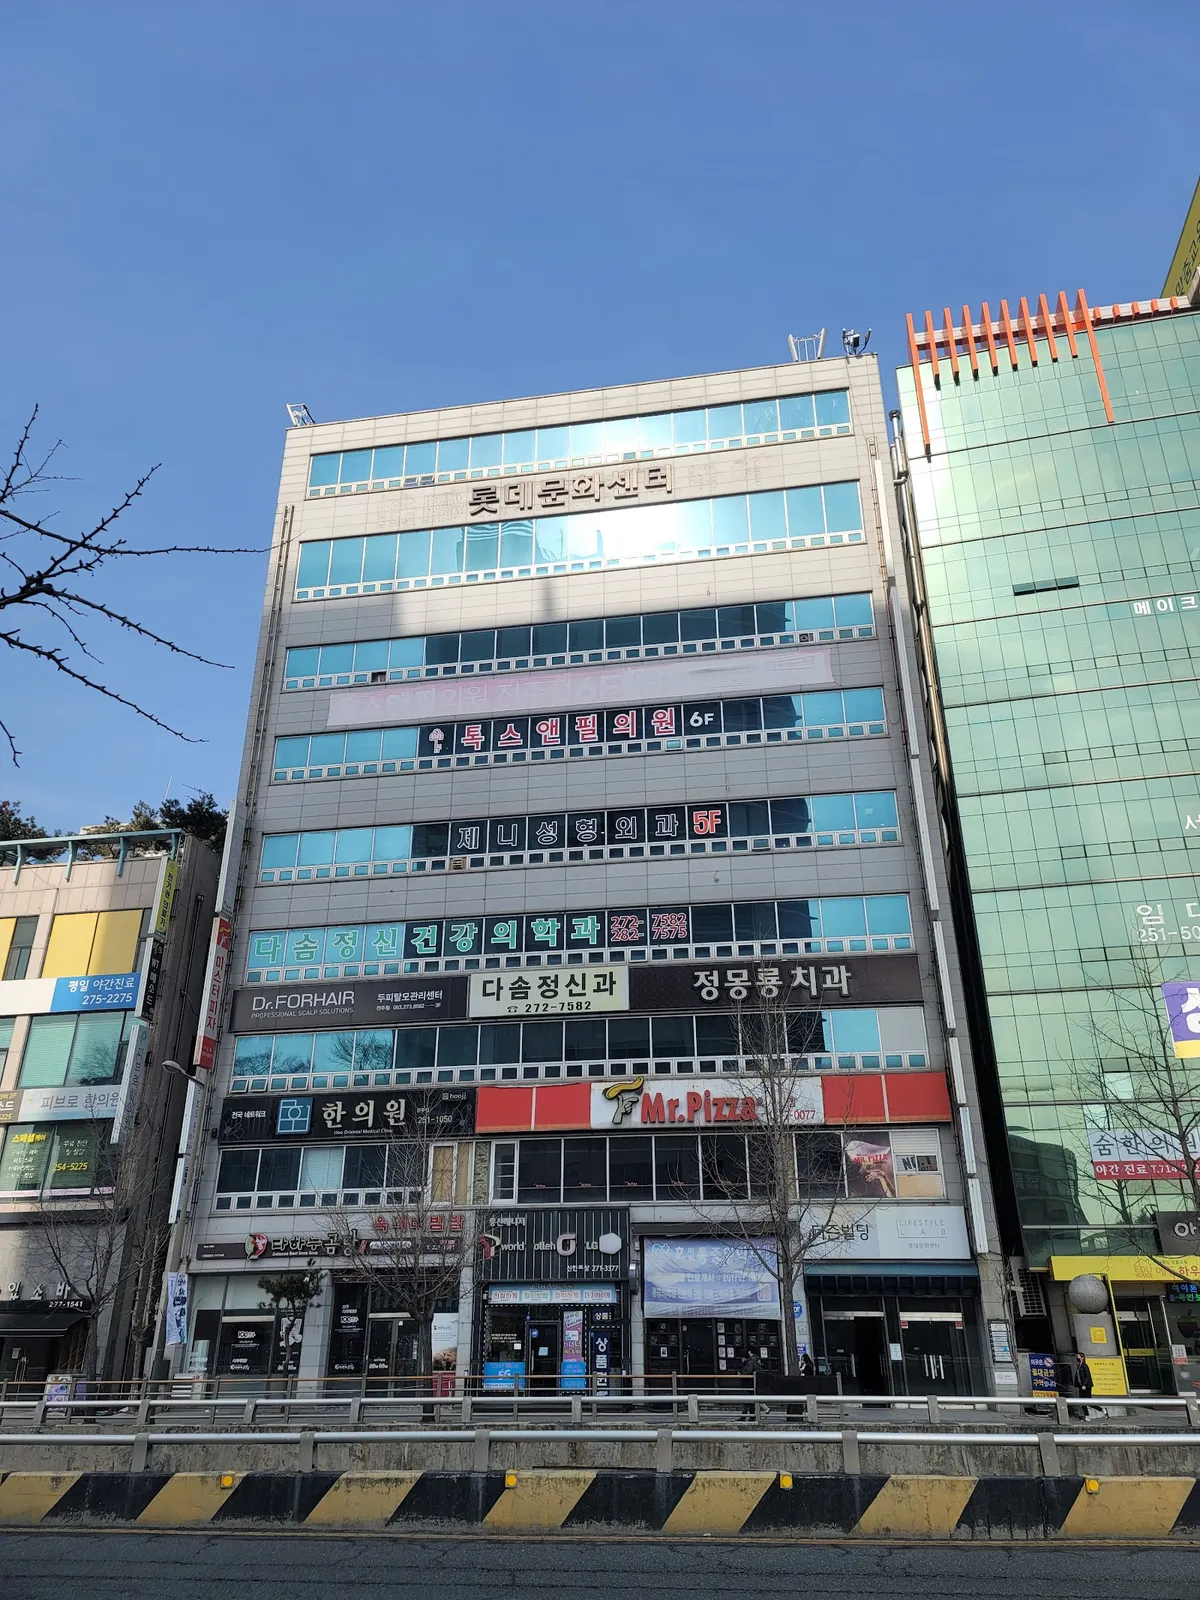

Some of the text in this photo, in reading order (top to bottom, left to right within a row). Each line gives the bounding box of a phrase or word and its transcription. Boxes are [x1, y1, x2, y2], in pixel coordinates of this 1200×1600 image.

[468, 464, 673, 517] 롯데문화센터
[1133, 596, 1198, 614] 메이크
[460, 707, 715, 751] 톡스앤필의원 6F
[457, 809, 722, 851] 제니성형외과 5F
[255, 914, 602, 964] 다솜정신건강의학과
[68, 976, 135, 993] 평일 야간진료
[481, 970, 617, 1001] 다솜정신과
[82, 991, 133, 1006] 275-2275
[206, 956, 225, 1032] 미스터피자
[377, 990, 443, 1004] 두피탈모관리센터
[251, 1007, 354, 1020] PROFESSIONAL SCALP SOLUTIONS
[525, 1000, 592, 1013] 272-7582
[40, 1095, 79, 1110] 피브로
[640, 1089, 759, 1124] Mr.Pizza
[322, 1098, 407, 1130] 한의원
[1096, 1163, 1120, 1176] 야간
[1124, 1163, 1148, 1175] 진료
[899, 1219, 945, 1227] LIFESTYLE
[501, 1241, 525, 1251] world
[586, 1241, 599, 1250] LG
[591, 1264, 619, 1272] 271-3377
